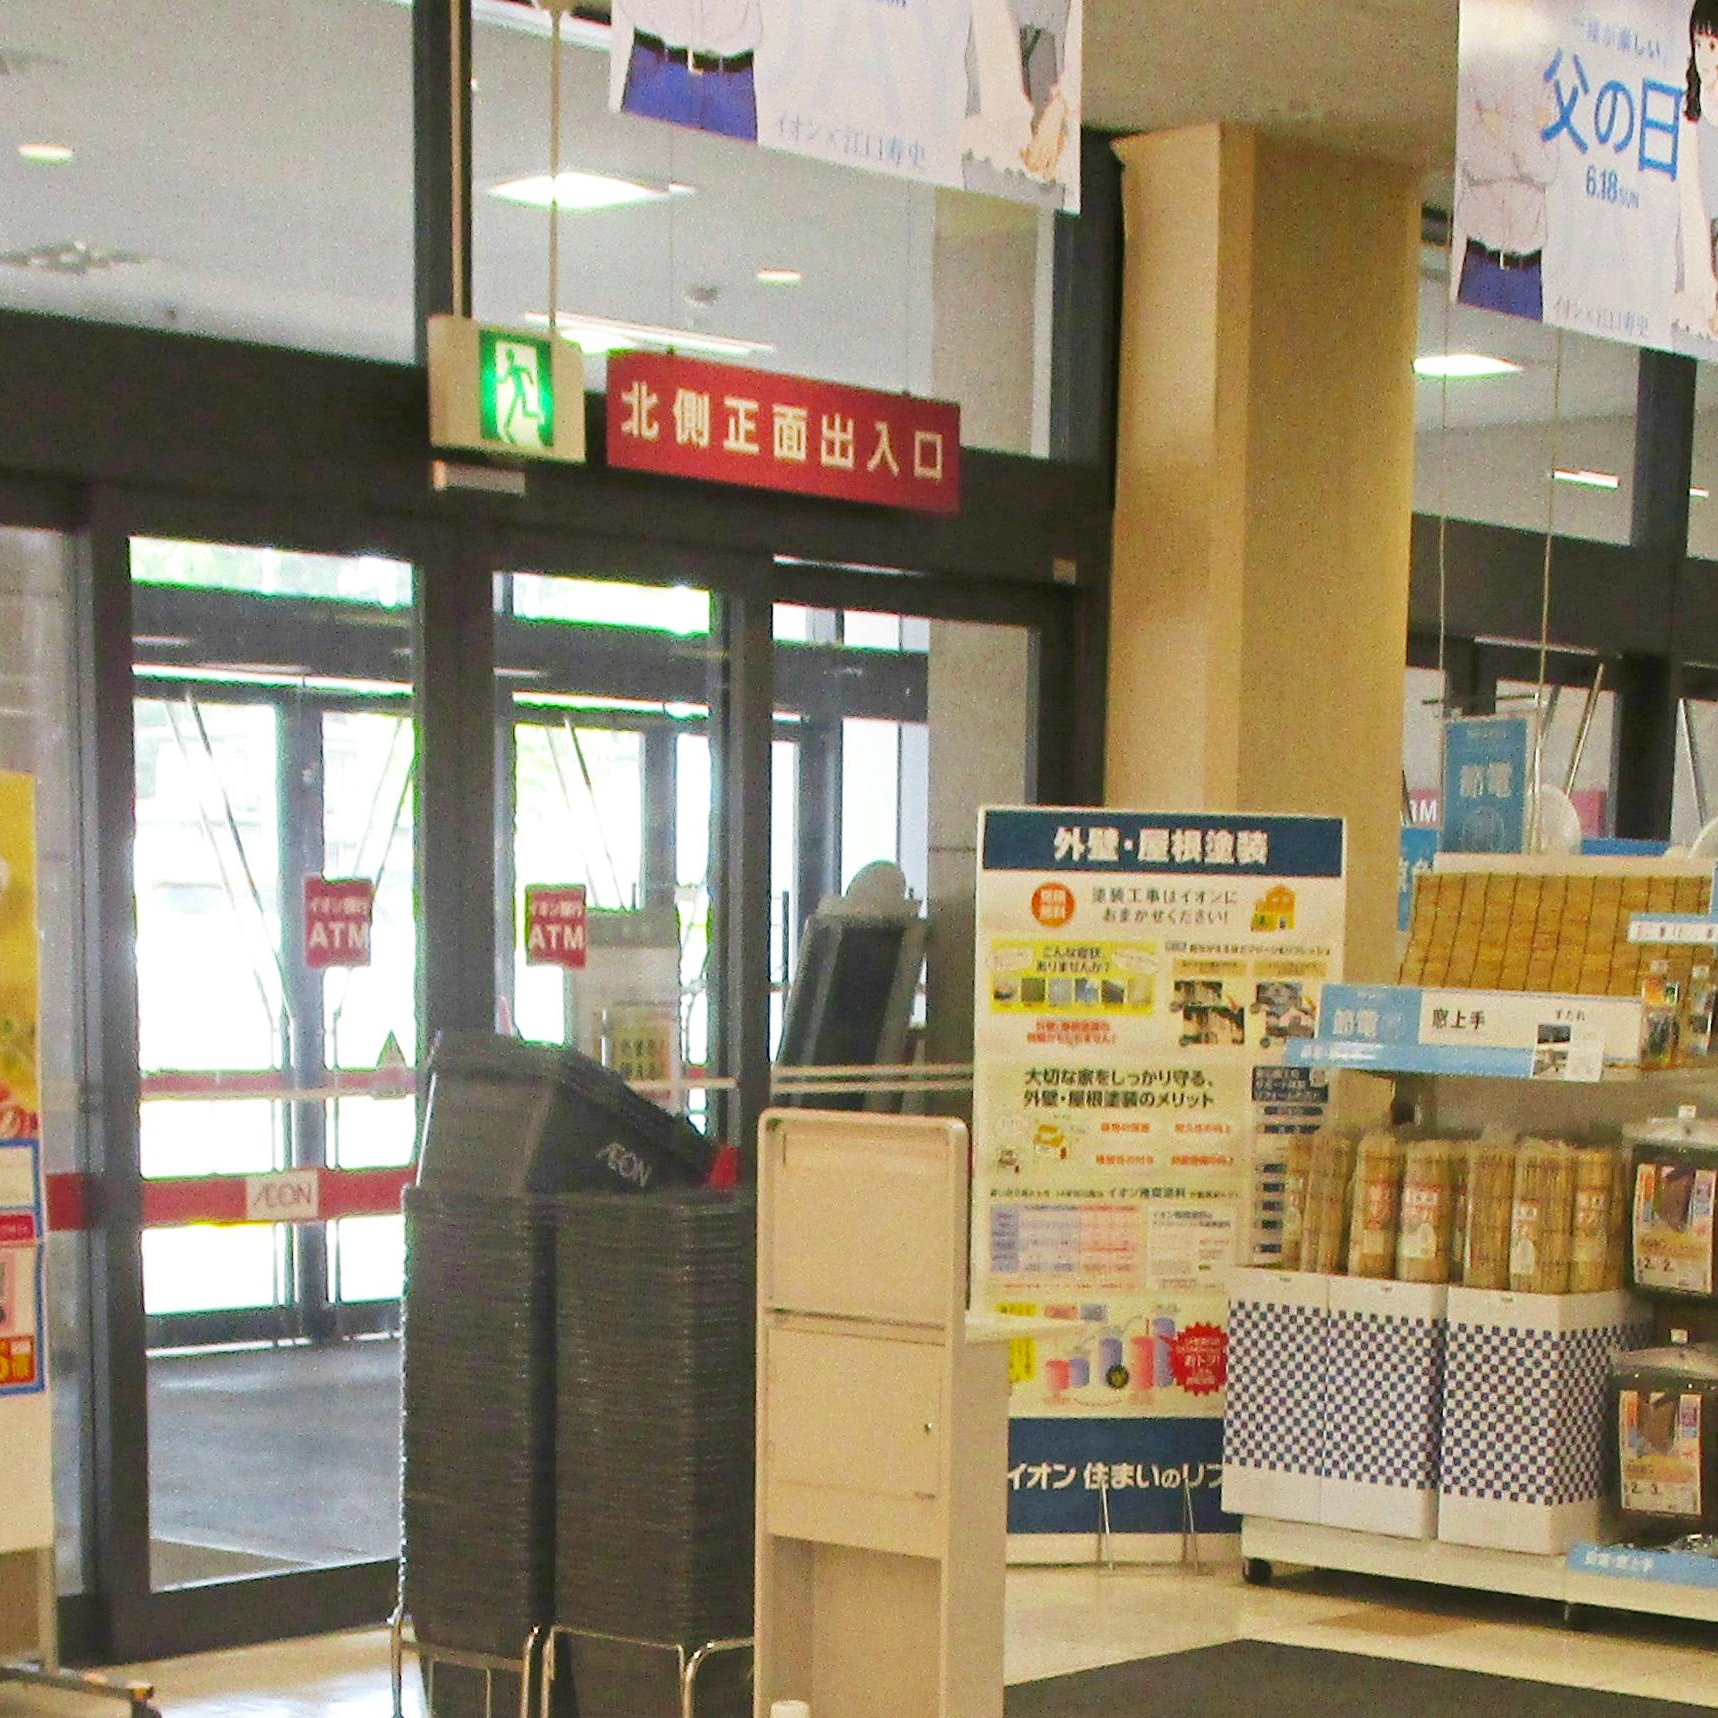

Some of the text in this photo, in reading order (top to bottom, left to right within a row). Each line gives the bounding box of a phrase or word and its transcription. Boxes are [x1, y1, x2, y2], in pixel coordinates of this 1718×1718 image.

[1541, 48, 1684, 181] 父の日
[621, 381, 943, 481] 北側正面出入口
[1054, 826, 1269, 865] 外壁・屋根塗装
[309, 922, 369, 950] ATM
[530, 924, 584, 951] ATM
[1025, 1066, 1214, 1088] 大切な家をしっかり守る、
[1023, 1089, 1214, 1110] 外壁・屋根塗装のメリット
[253, 1182, 313, 1208] AEON
